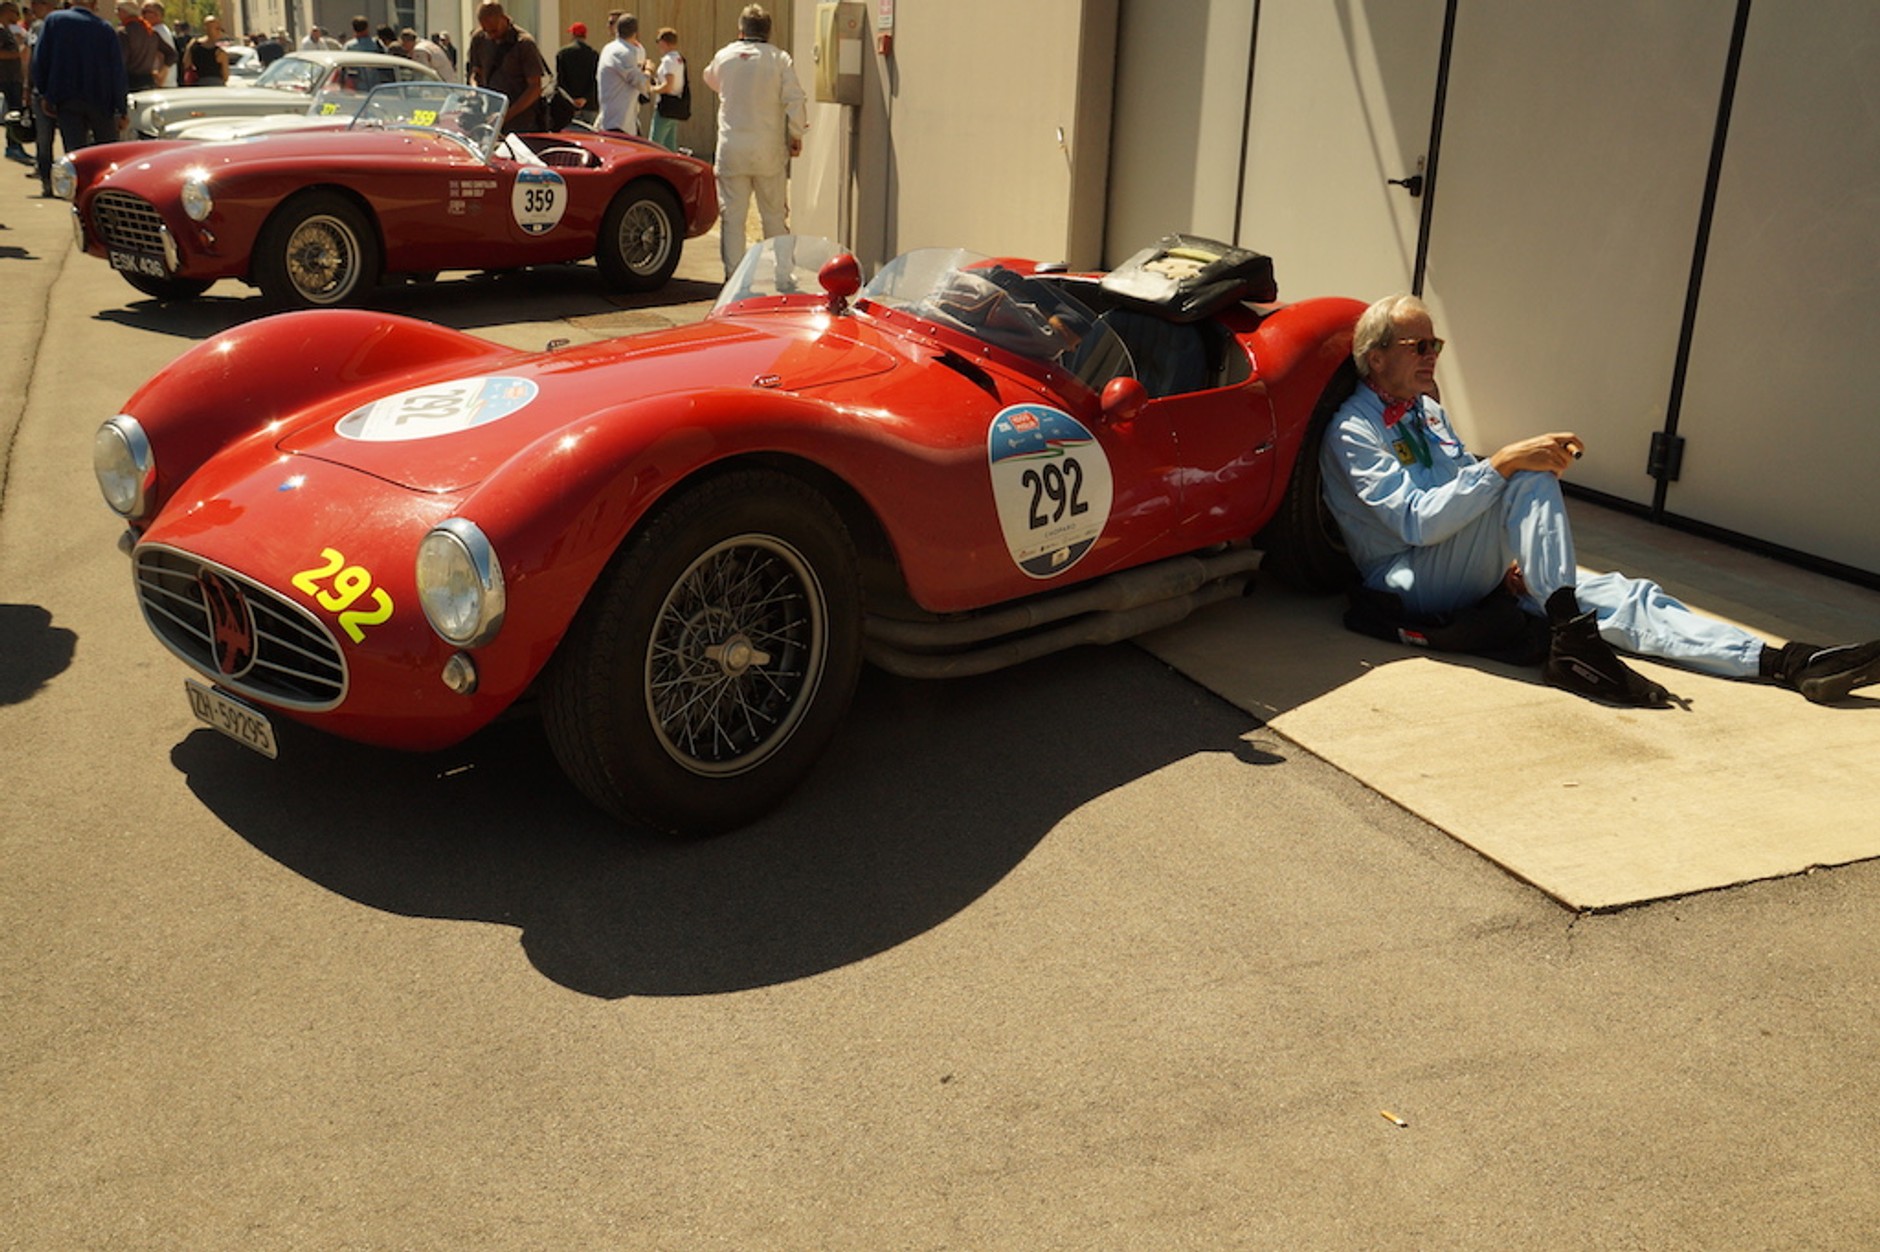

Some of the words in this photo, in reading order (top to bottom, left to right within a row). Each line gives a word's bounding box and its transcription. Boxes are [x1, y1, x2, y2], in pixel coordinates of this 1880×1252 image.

[409, 110, 437, 126] 359
[525, 189, 554, 212] 359
[111, 251, 138, 272] ESK
[139, 257, 165, 277] 436
[395, 389, 466, 425] 292
[1022, 457, 1088, 530] 292
[291, 547, 394, 644] 292
